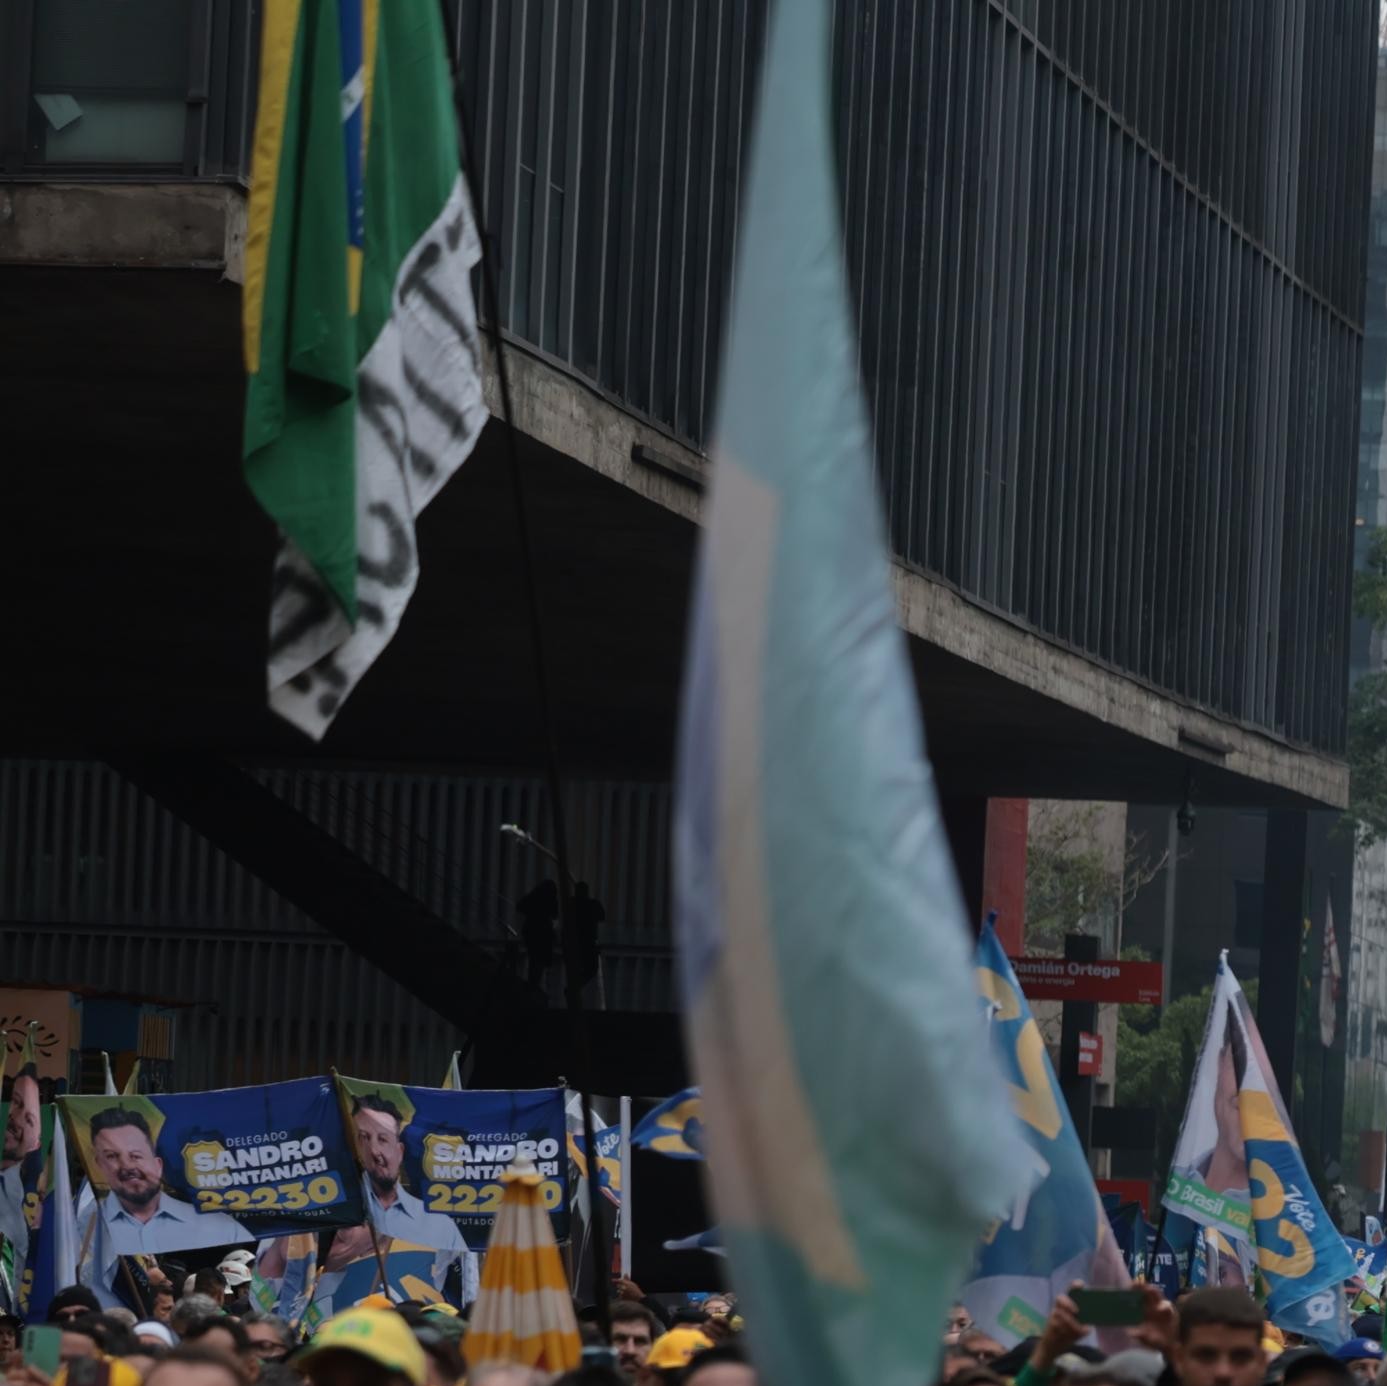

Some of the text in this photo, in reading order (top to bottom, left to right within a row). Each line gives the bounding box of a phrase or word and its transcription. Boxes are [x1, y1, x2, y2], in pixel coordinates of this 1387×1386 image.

[1067, 962, 1120, 979] Ortega
[225, 1130, 288, 1148] DELEGADO
[432, 1138, 560, 1164] SANDRO
[466, 1132, 528, 1143] DELEGADO
[192, 1135, 324, 1172] SANDRO
[196, 1156, 329, 1188] MONTANARI
[196, 1175, 340, 1212] 22230
[426, 1180, 563, 1214] 2220
[1180, 1185, 1226, 1216] Brasil
[1283, 1183, 1317, 1233] Vote
